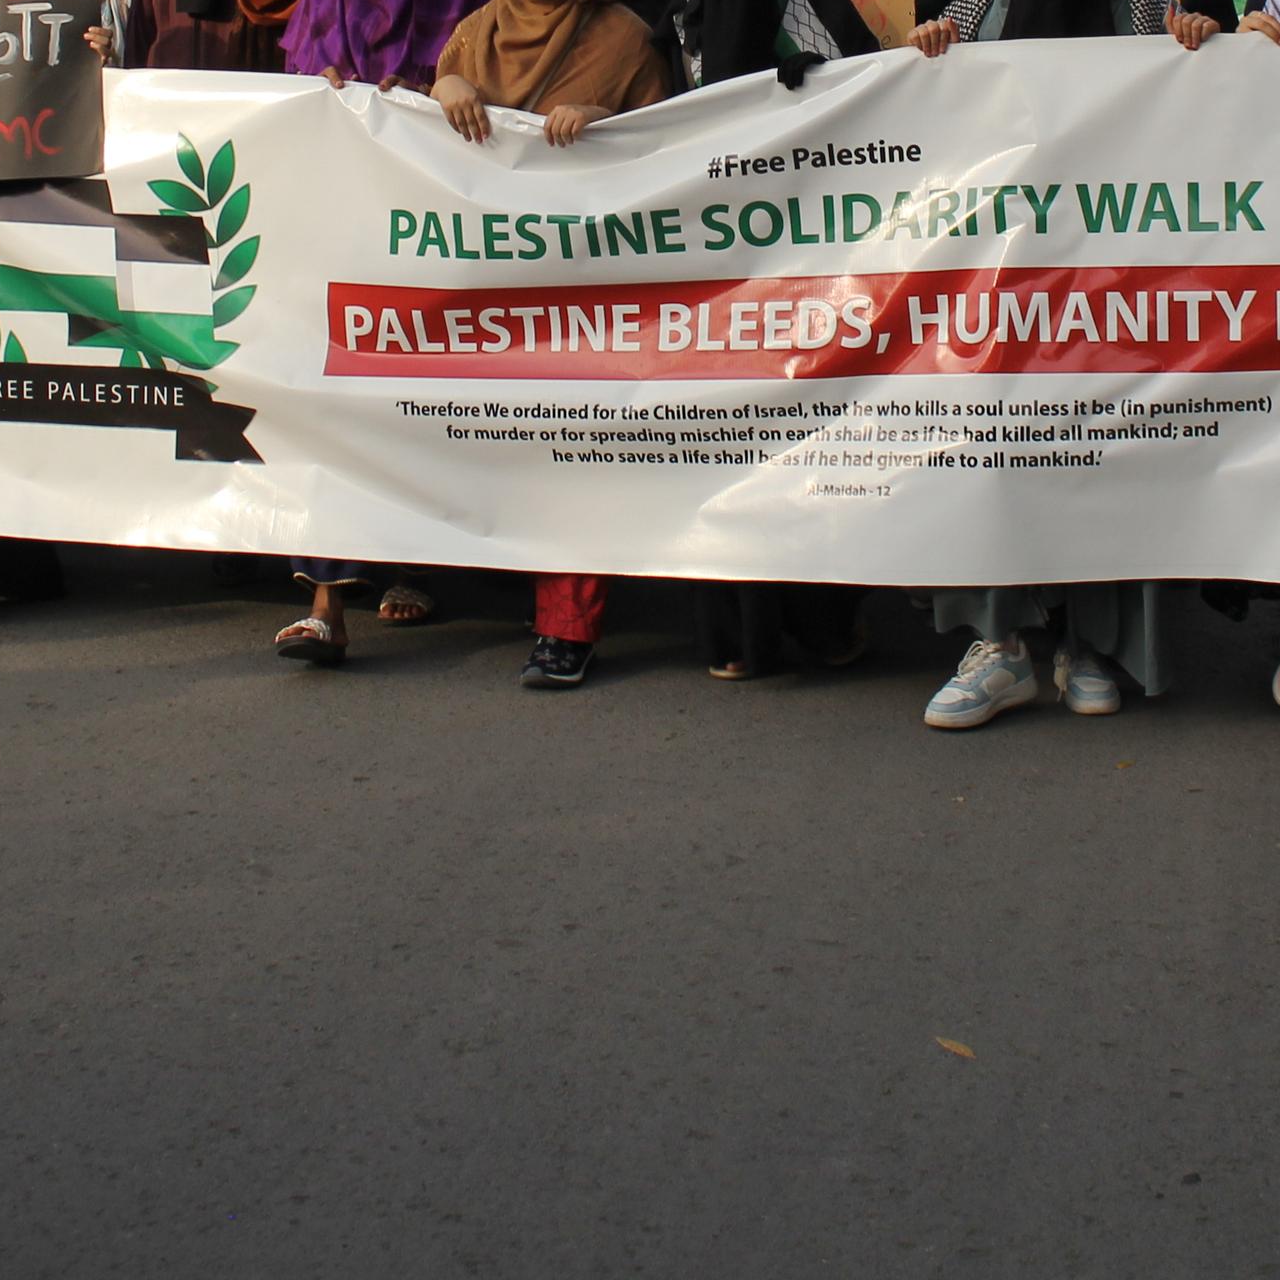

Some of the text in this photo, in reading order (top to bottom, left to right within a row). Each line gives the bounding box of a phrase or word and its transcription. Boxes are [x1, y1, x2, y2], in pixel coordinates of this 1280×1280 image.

[707, 139, 922, 178] #Free Palestine
[389, 180, 1266, 261] PALESTINE SOLIDARITY WALK
[345, 303, 641, 354] PALESTINE
[657, 295, 893, 355] BLEEDS,
[907, 289, 1256, 345] HUMANITY
[47, 382, 185, 407] PALESTINE
[484, 403, 509, 418] We
[513, 403, 588, 420] ordained
[593, 404, 617, 421] for
[621, 405, 649, 421] the
[654, 405, 727, 421] Children
[732, 404, 751, 420] of
[754, 402, 808, 420] Israel,
[812, 401, 848, 417] that
[853, 401, 872, 417] he
[876, 401, 911, 417] who
[915, 400, 948, 417] kills
[952, 405, 961, 417] a
[966, 400, 1003, 417] soul
[1009, 400, 1069, 417] unless
[1074, 399, 1087, 416] it
[1092, 399, 1115, 416] be
[1121, 399, 1145, 418] (in
[1150, 396, 1272, 418] punishment)
